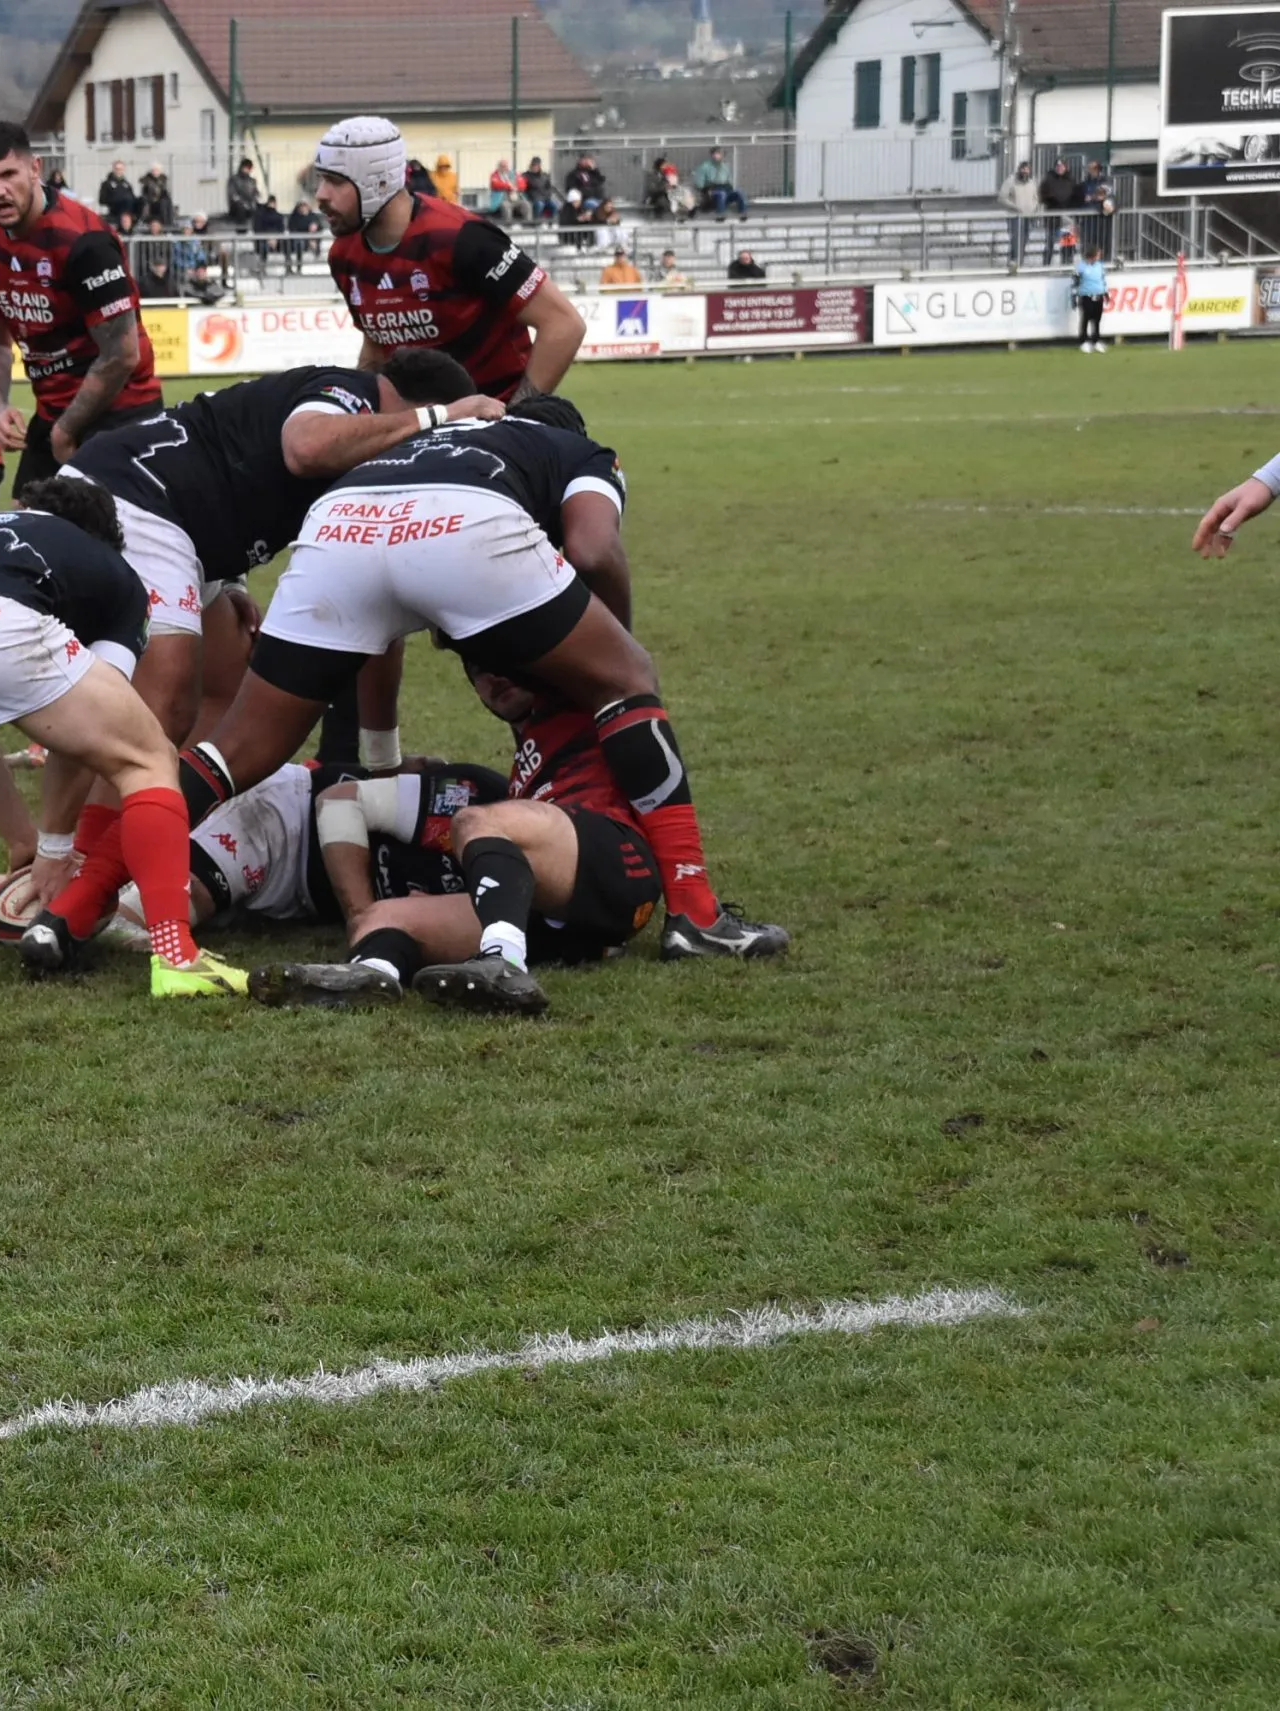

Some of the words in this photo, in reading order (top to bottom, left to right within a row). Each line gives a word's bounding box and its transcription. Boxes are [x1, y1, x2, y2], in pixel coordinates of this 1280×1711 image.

[485, 243, 521, 282] Tefal
[82, 265, 126, 291] Tefal
[262, 310, 352, 333] DELEV
[360, 313, 374, 329] LE
[377, 309, 433, 328] GRAND
[328, 499, 417, 518] FRANCE
